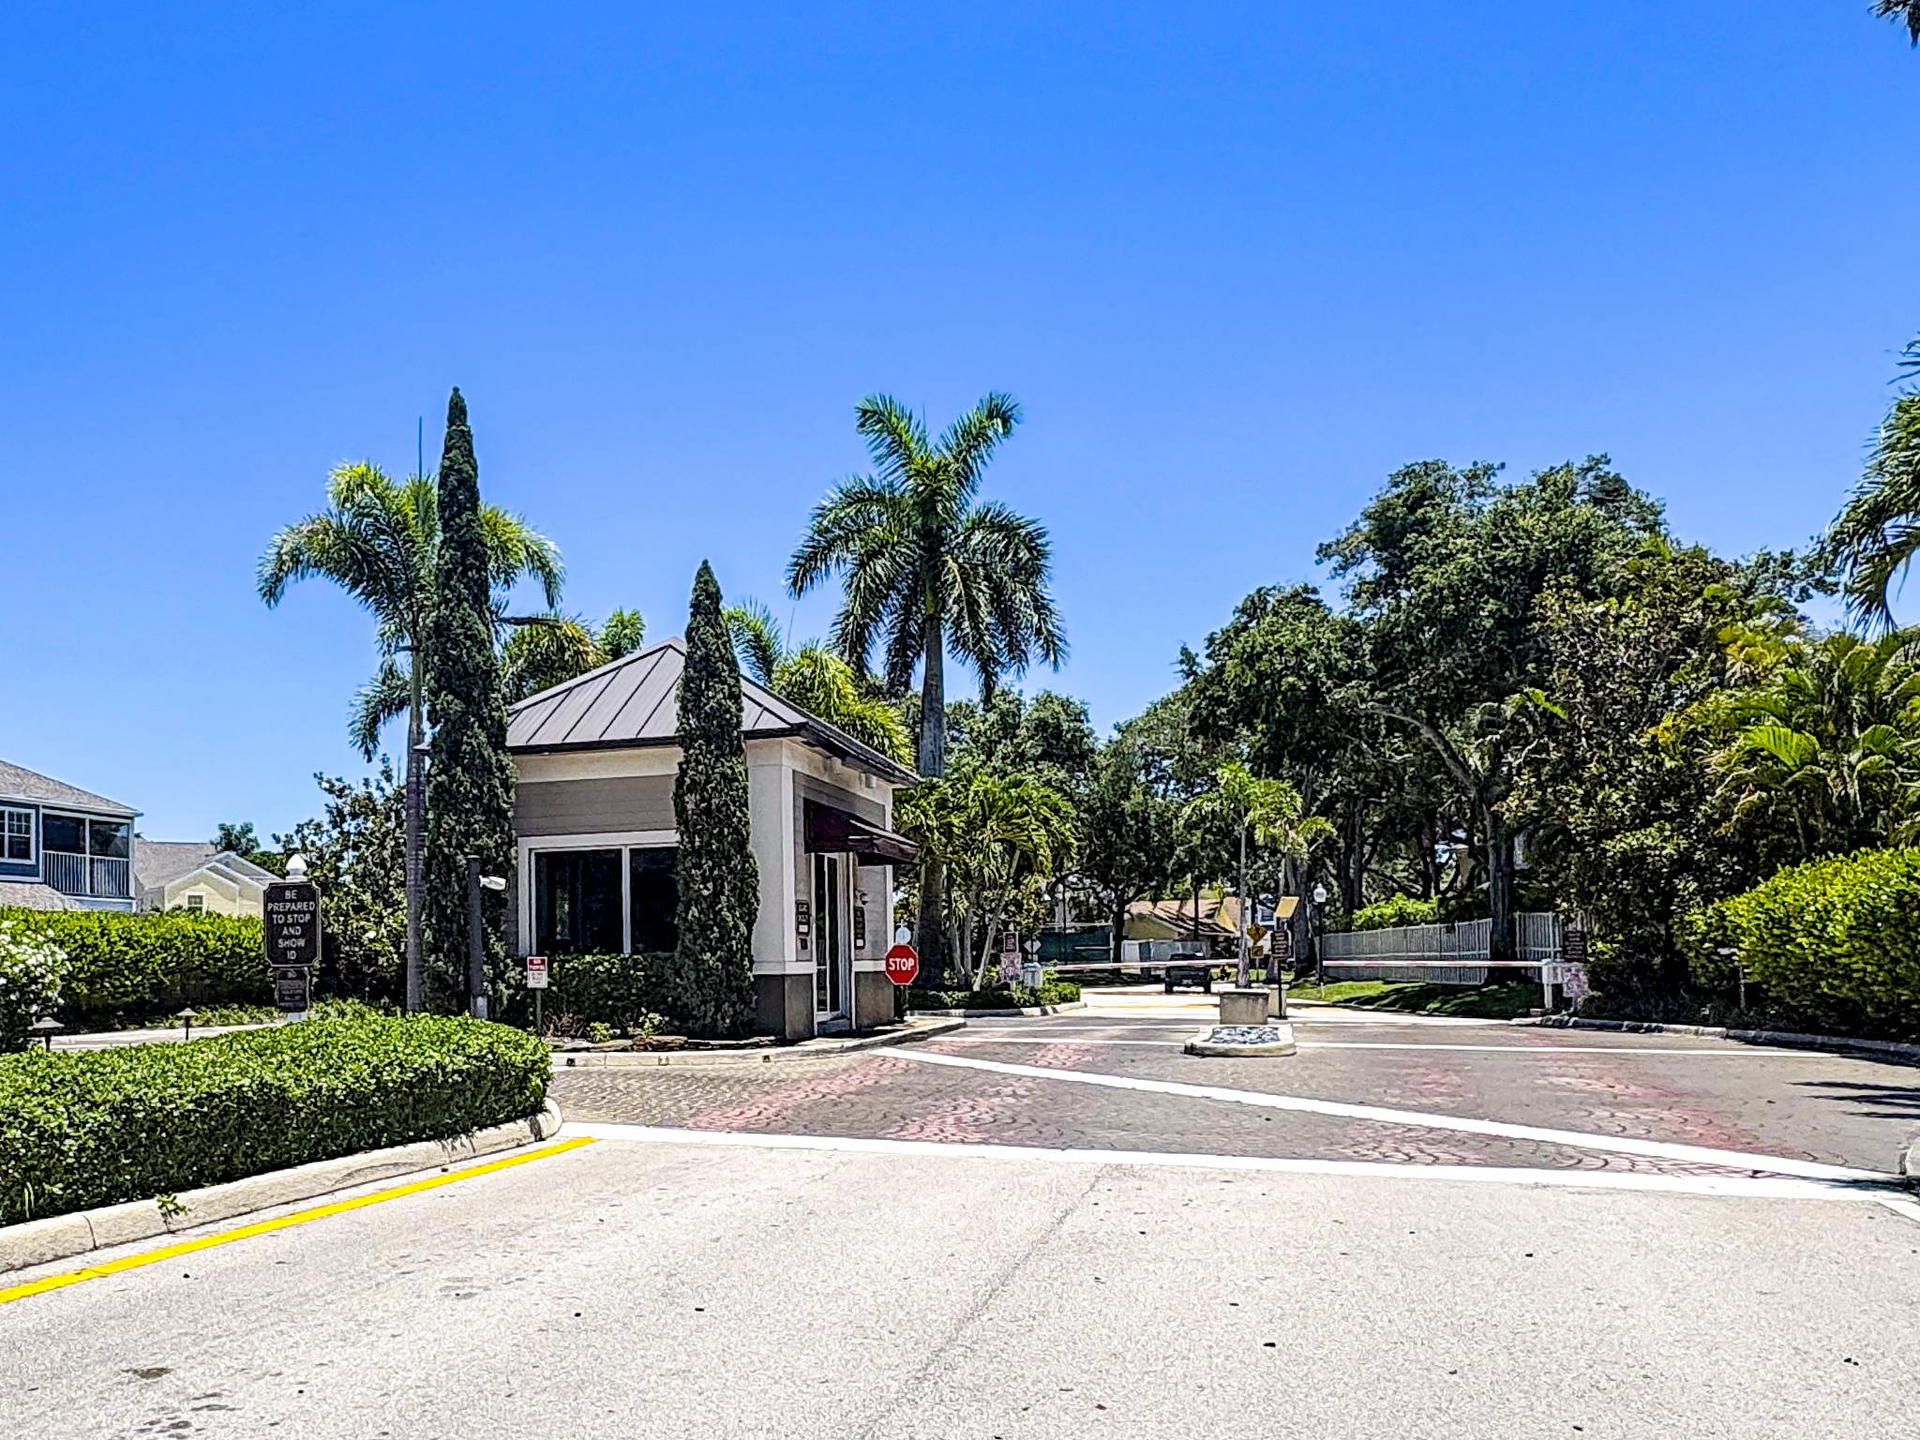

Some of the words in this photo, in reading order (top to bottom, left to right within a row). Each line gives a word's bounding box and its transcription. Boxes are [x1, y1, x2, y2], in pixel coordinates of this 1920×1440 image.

[285, 890, 298, 900] BE
[267, 902, 315, 912] PREPARED
[272, 914, 285, 924] TO
[286, 913, 310, 924] STOP
[282, 926, 302, 936] AND
[278, 938, 306, 948] SHOW
[286, 950, 297, 960] ID
[888, 957, 915, 970] STOP
